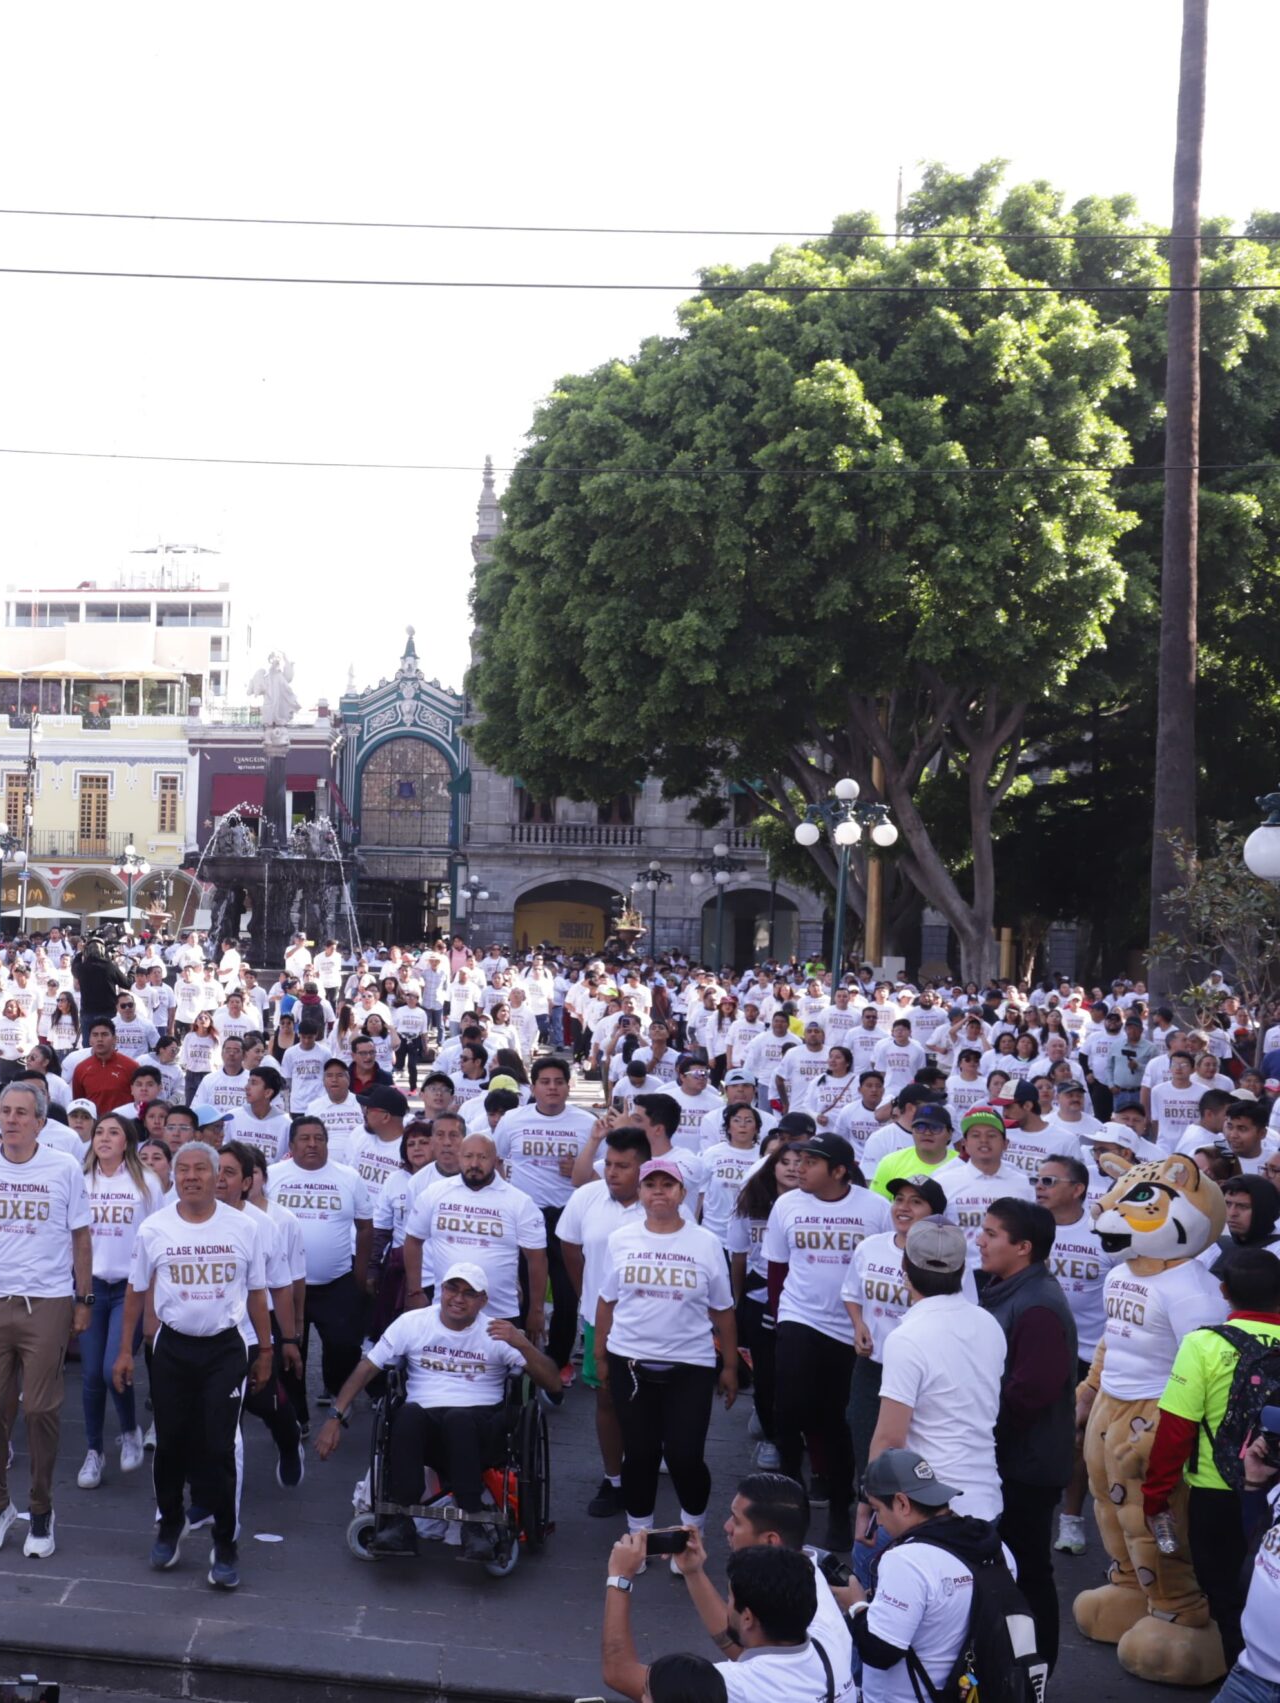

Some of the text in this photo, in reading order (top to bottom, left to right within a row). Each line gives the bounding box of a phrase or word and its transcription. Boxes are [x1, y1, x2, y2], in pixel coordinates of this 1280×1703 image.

[214, 1095, 247, 1106] BOXE
[236, 1130, 279, 1142] CLASE NACIONAL
[1018, 1145, 1047, 1154] NACIONAL
[11, 1183, 51, 1194] NACIONAL
[304, 1183, 339, 1191] NACIONAL
[277, 1194, 342, 1211] BOXEO
[955, 1197, 979, 1205] CLASE
[439, 1202, 502, 1217] CLASE NACIONAL
[436, 1216, 504, 1238] BOXEO
[794, 1216, 865, 1226] CLASE NACIONAL
[166, 1245, 235, 1256] CLASE NACIONAL
[1055, 1242, 1099, 1256] NACIONAL
[627, 1252, 697, 1265] CLASE NACIONAL
[168, 1262, 237, 1285] BOXEO
[868, 1263, 895, 1276] CLASE
[1045, 1258, 1100, 1280] XEO
[624, 1266, 698, 1289] BOXEO
[1121, 1281, 1149, 1297] NACIONAL
[1106, 1297, 1145, 1326] OXEO
[422, 1345, 487, 1361] CLASE NACIONAL
